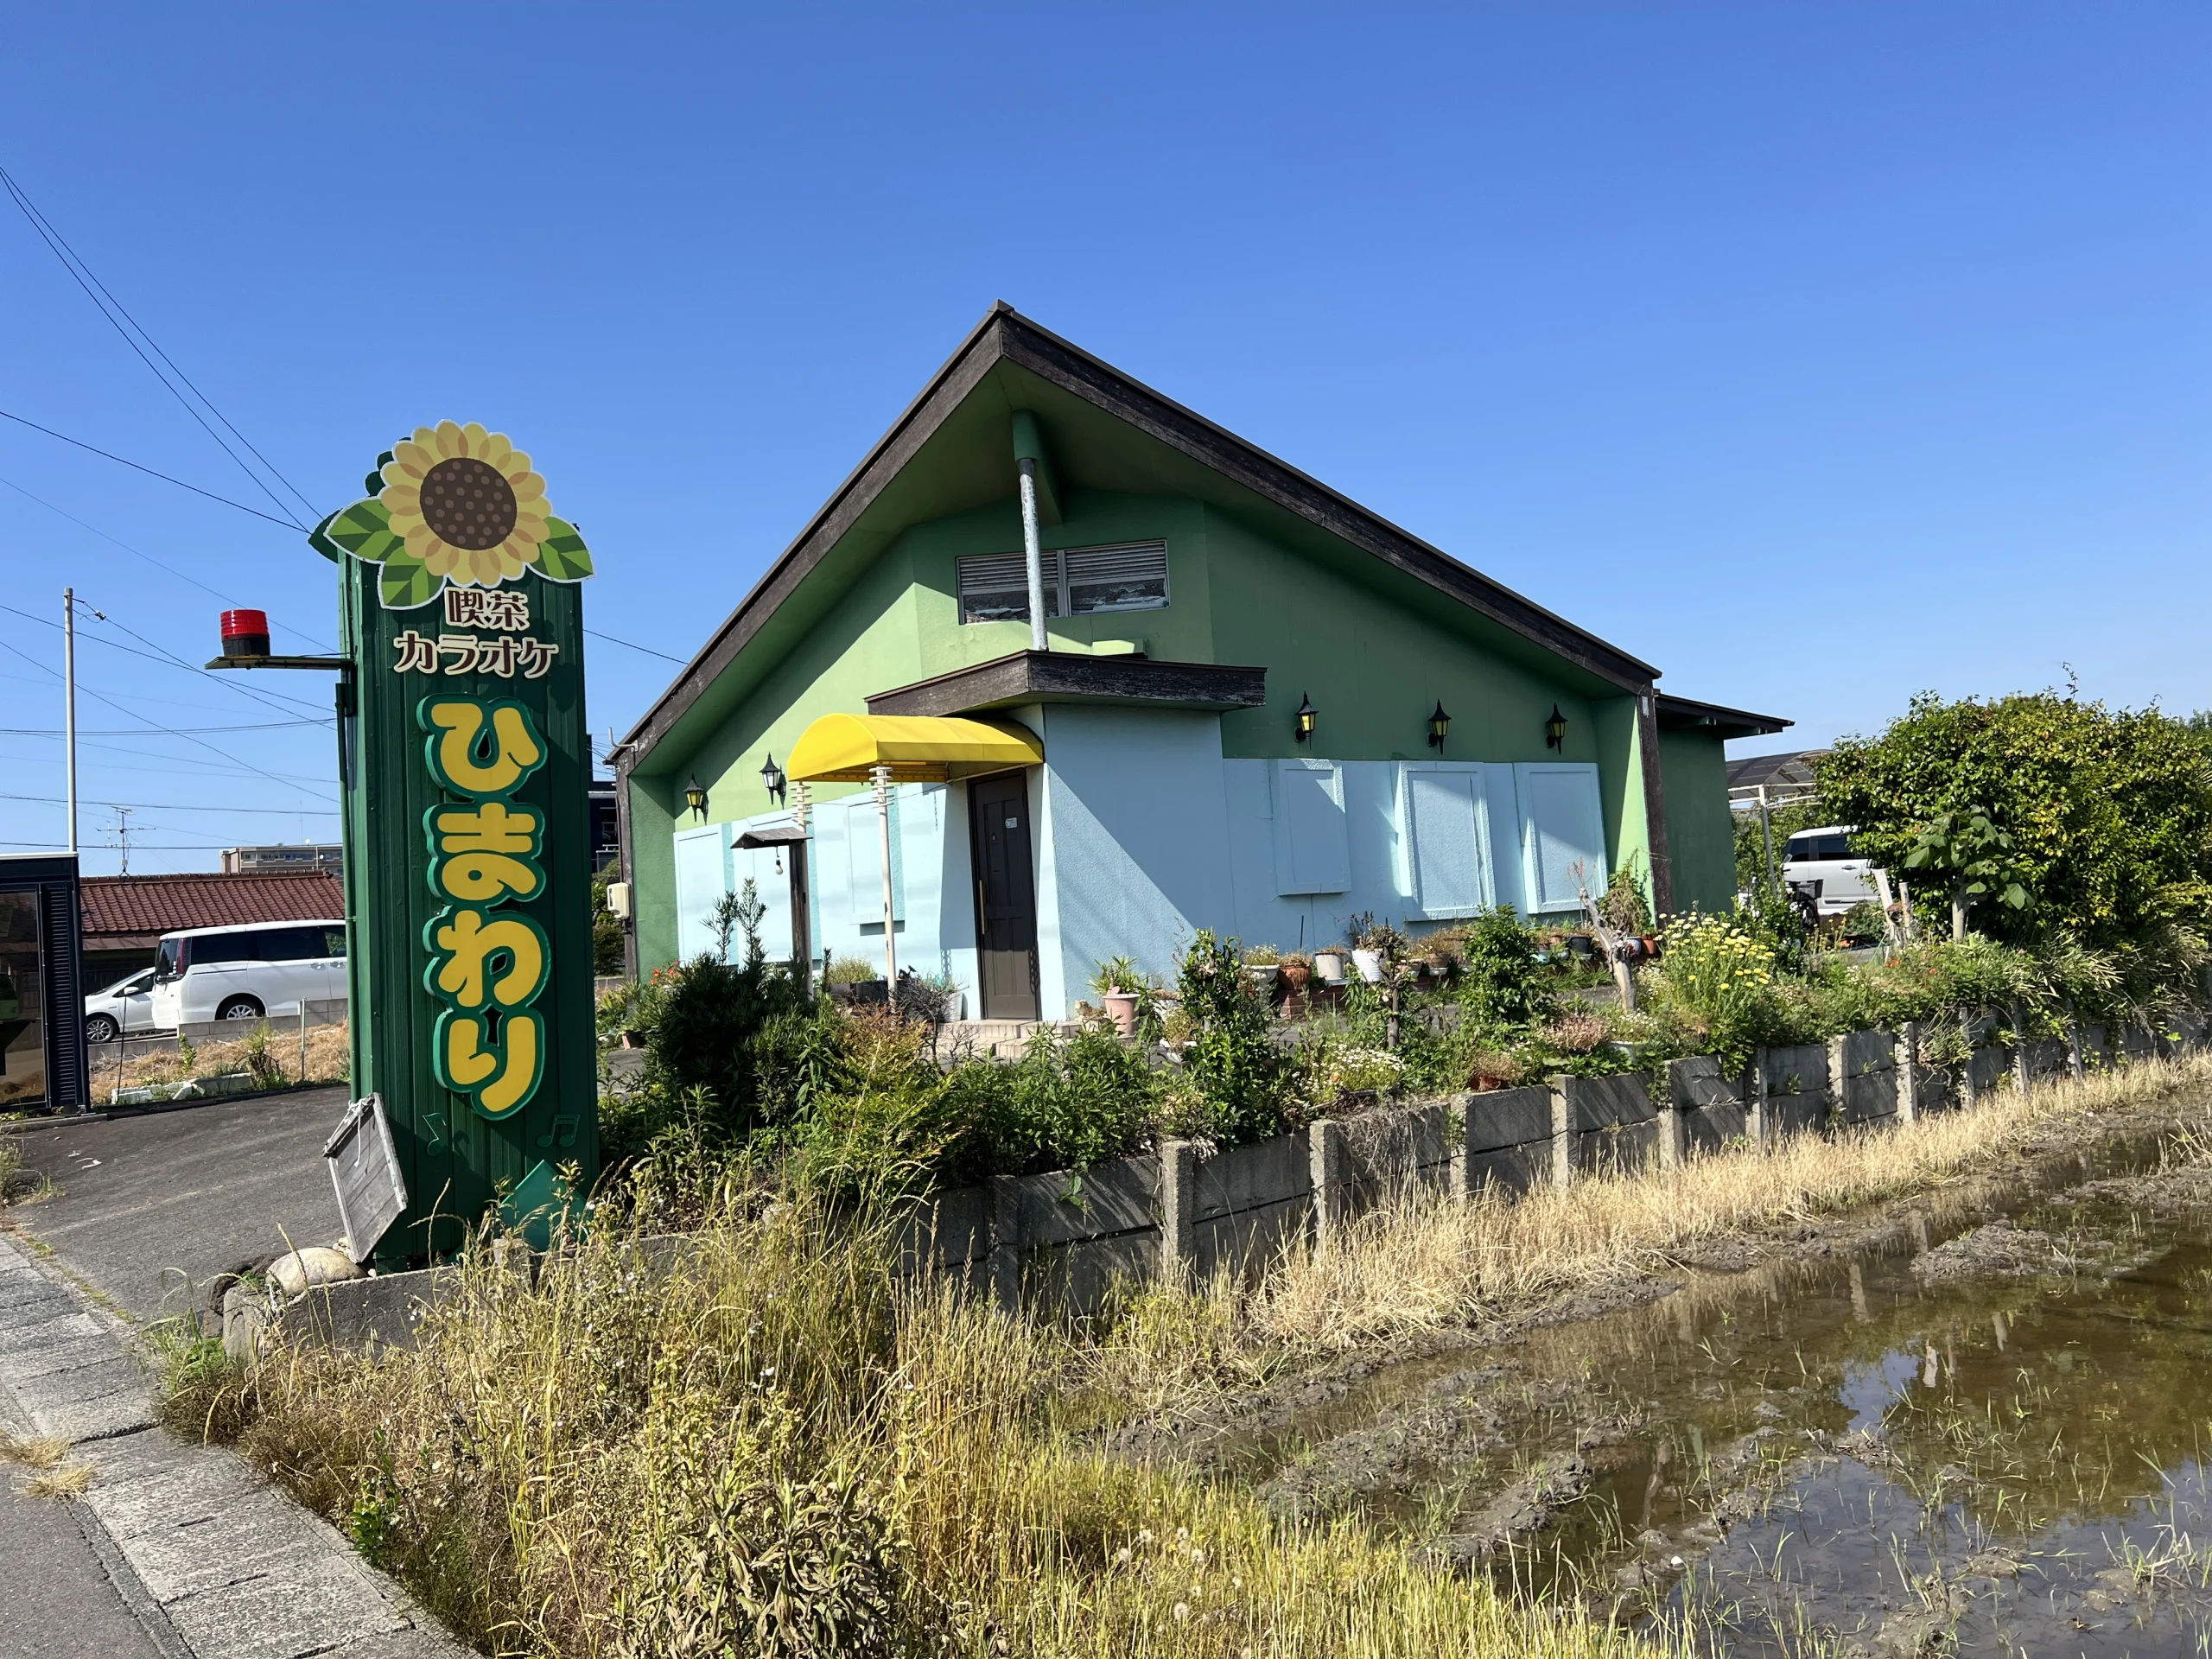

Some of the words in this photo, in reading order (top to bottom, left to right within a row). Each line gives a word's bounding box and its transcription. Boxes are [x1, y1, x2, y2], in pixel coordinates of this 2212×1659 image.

[447, 588, 528, 629] 喫茶
[396, 632, 557, 677] カラオケ
[429, 701, 543, 1115] ひまわり
